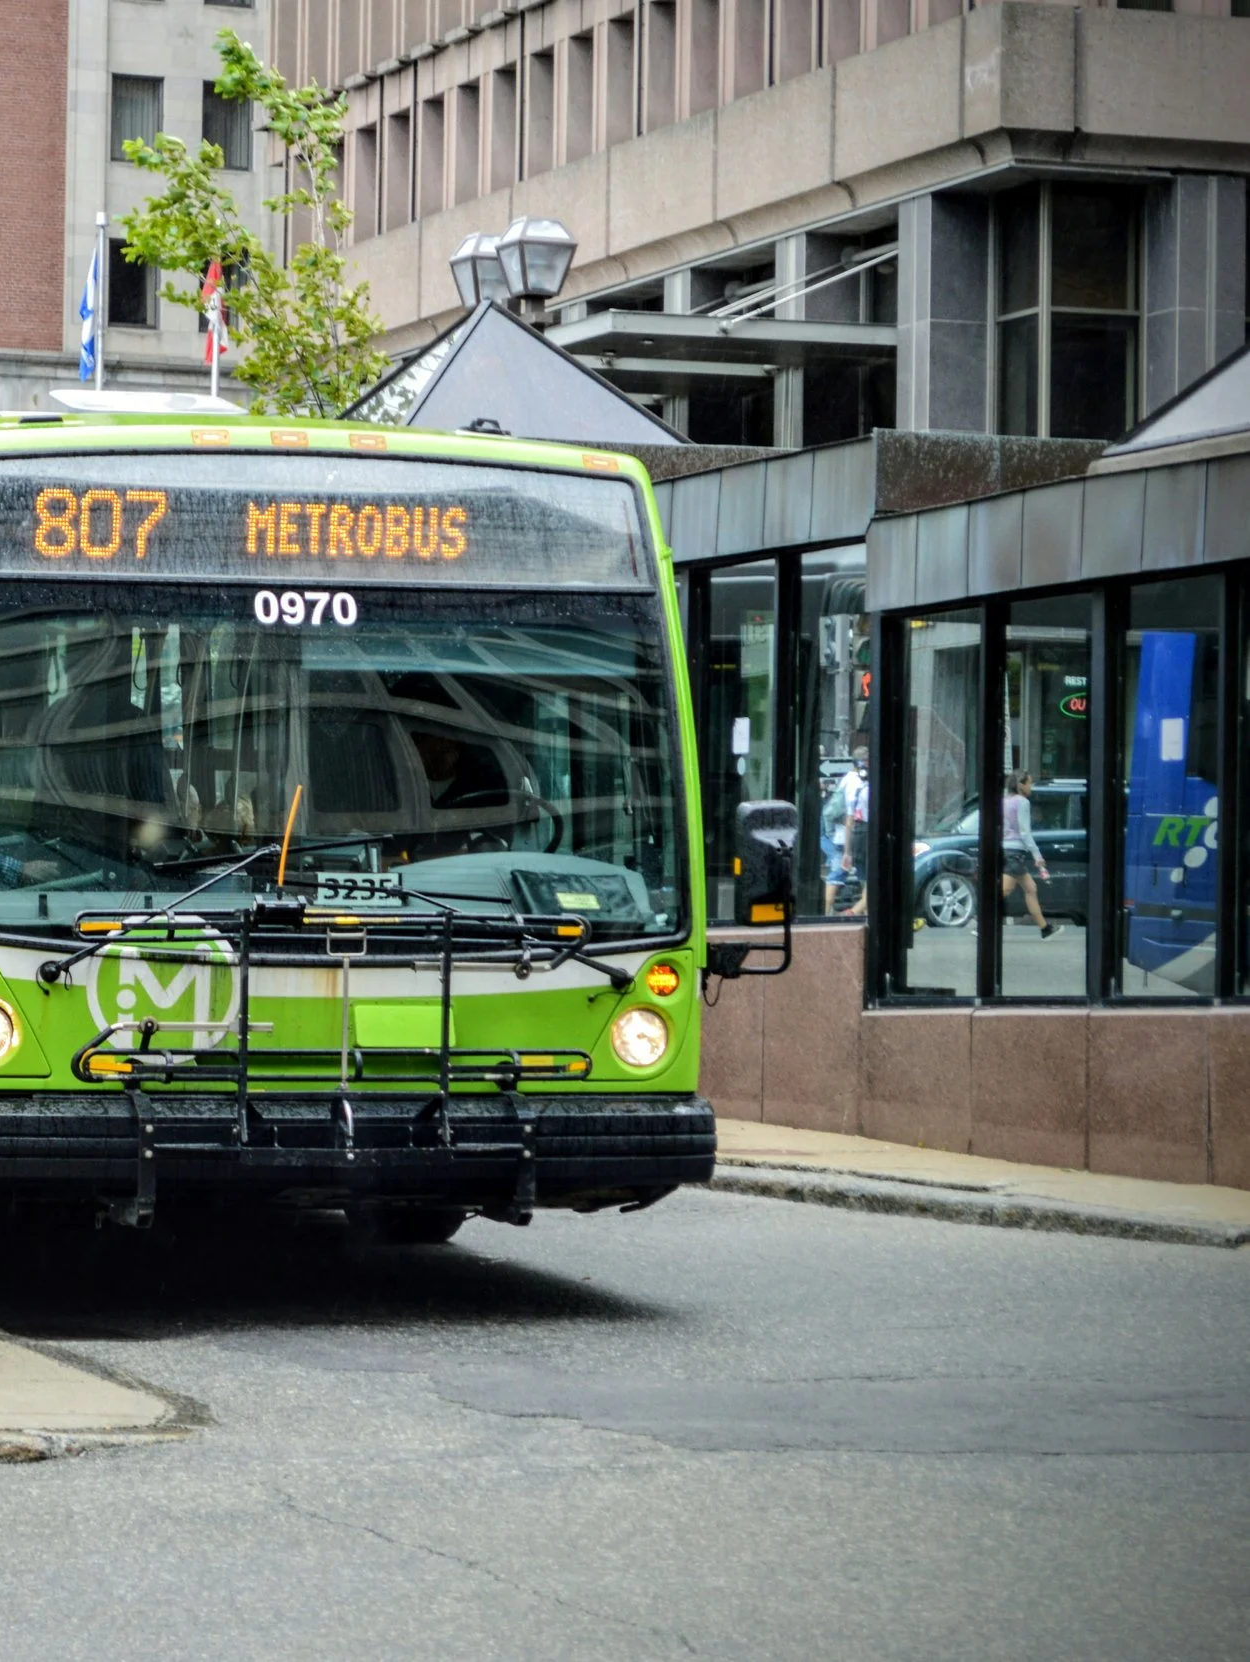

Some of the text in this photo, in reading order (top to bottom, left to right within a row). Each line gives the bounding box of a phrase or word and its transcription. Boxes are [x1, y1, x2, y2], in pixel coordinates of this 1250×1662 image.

[35, 488, 469, 560] 807 METROBUS
[254, 590, 358, 627] 0970
[1065, 675, 1087, 687] REST
[324, 878, 393, 900] 3235
